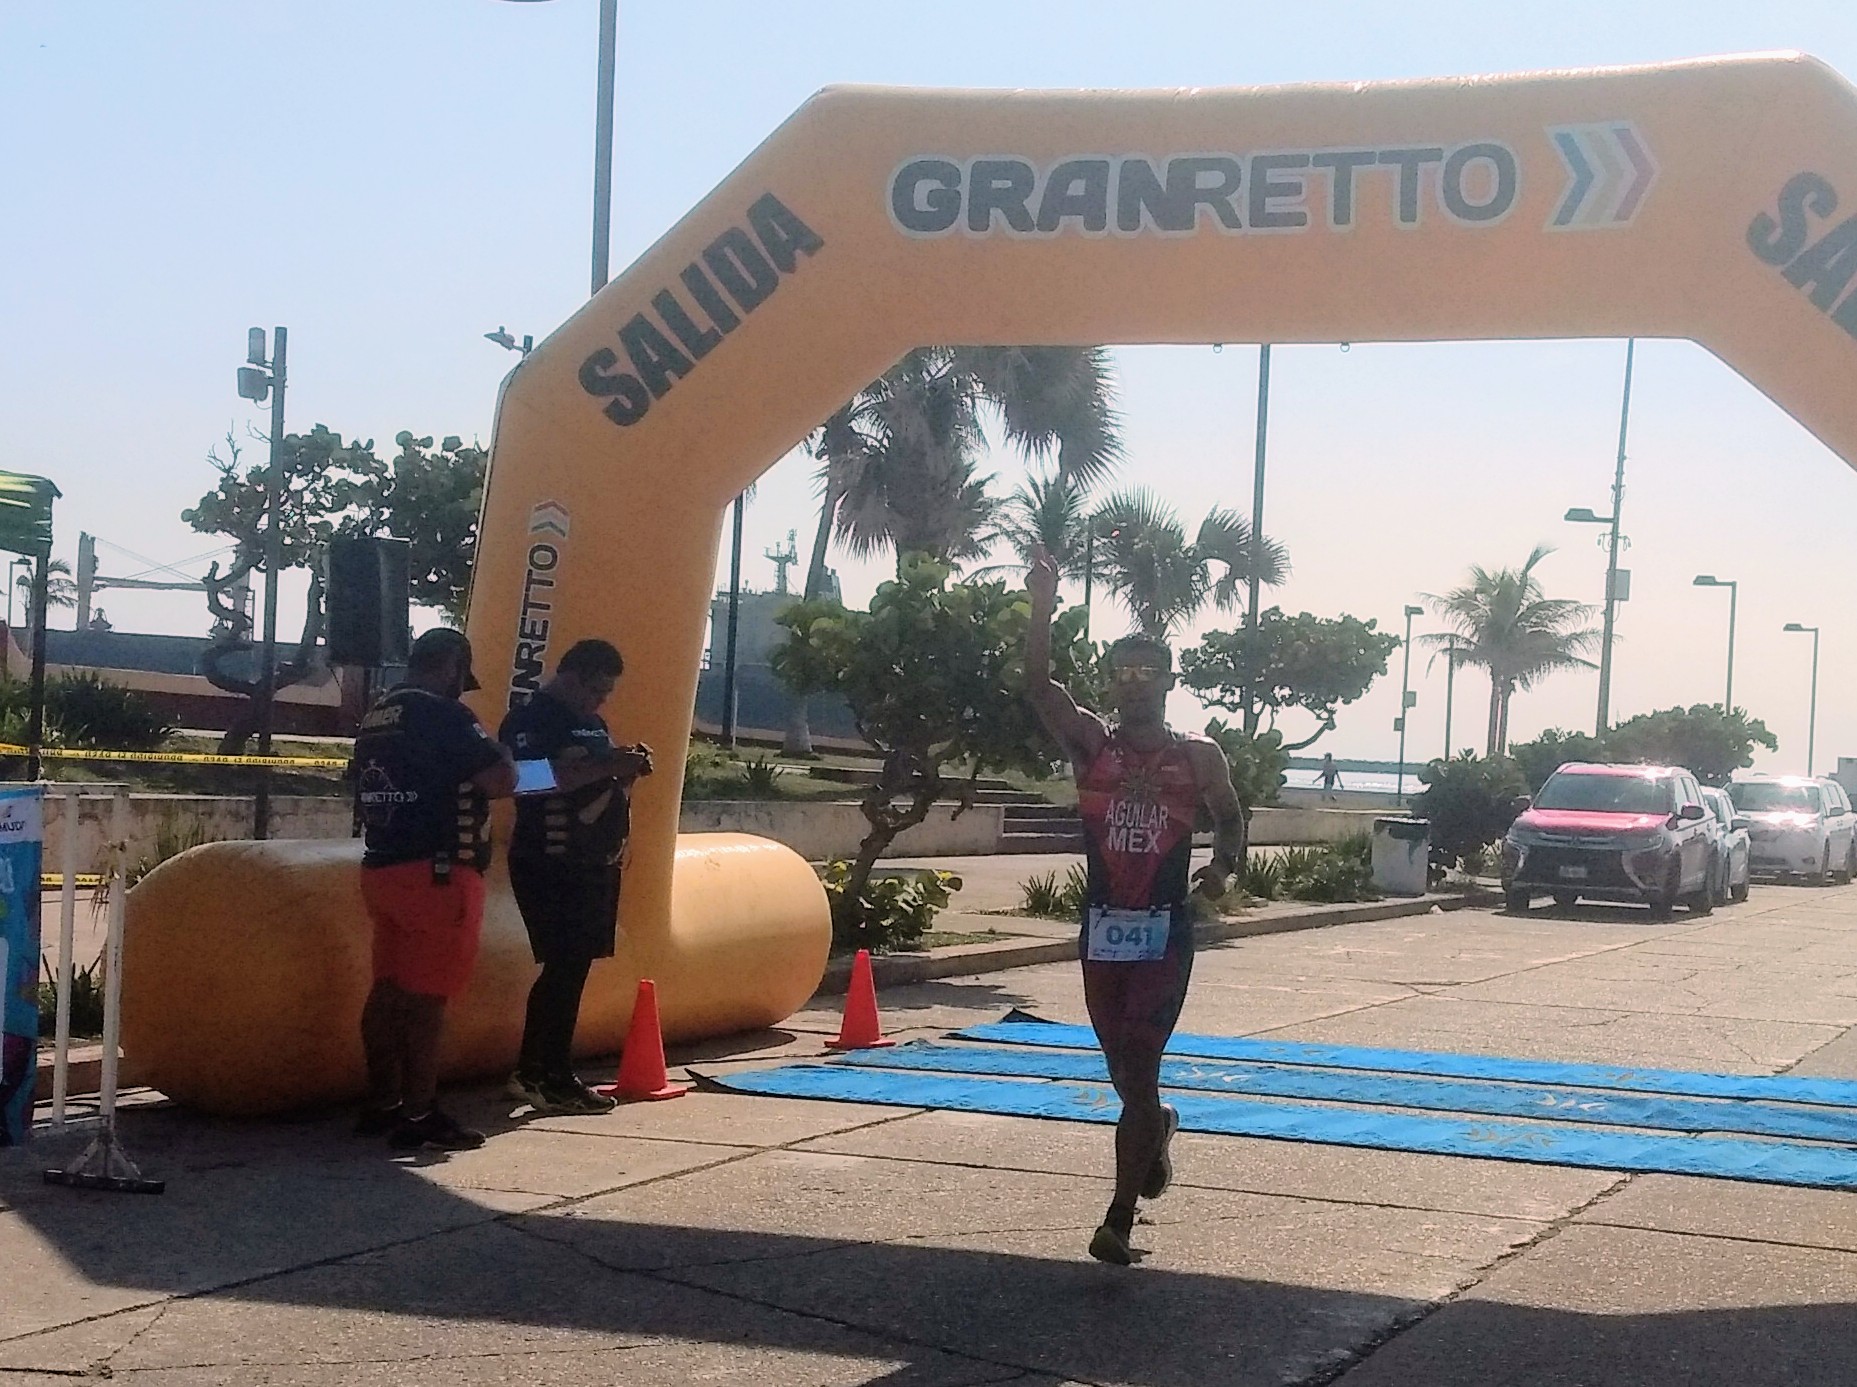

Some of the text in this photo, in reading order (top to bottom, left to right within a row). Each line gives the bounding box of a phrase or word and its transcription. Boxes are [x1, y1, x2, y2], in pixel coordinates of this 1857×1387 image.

[889, 141, 1518, 234] GRANRETTO
[578, 192, 825, 427] SALIDA
[1105, 800, 1169, 830] AGUILAR
[1108, 827, 1162, 854] MEX
[1106, 925, 1153, 947] 041
